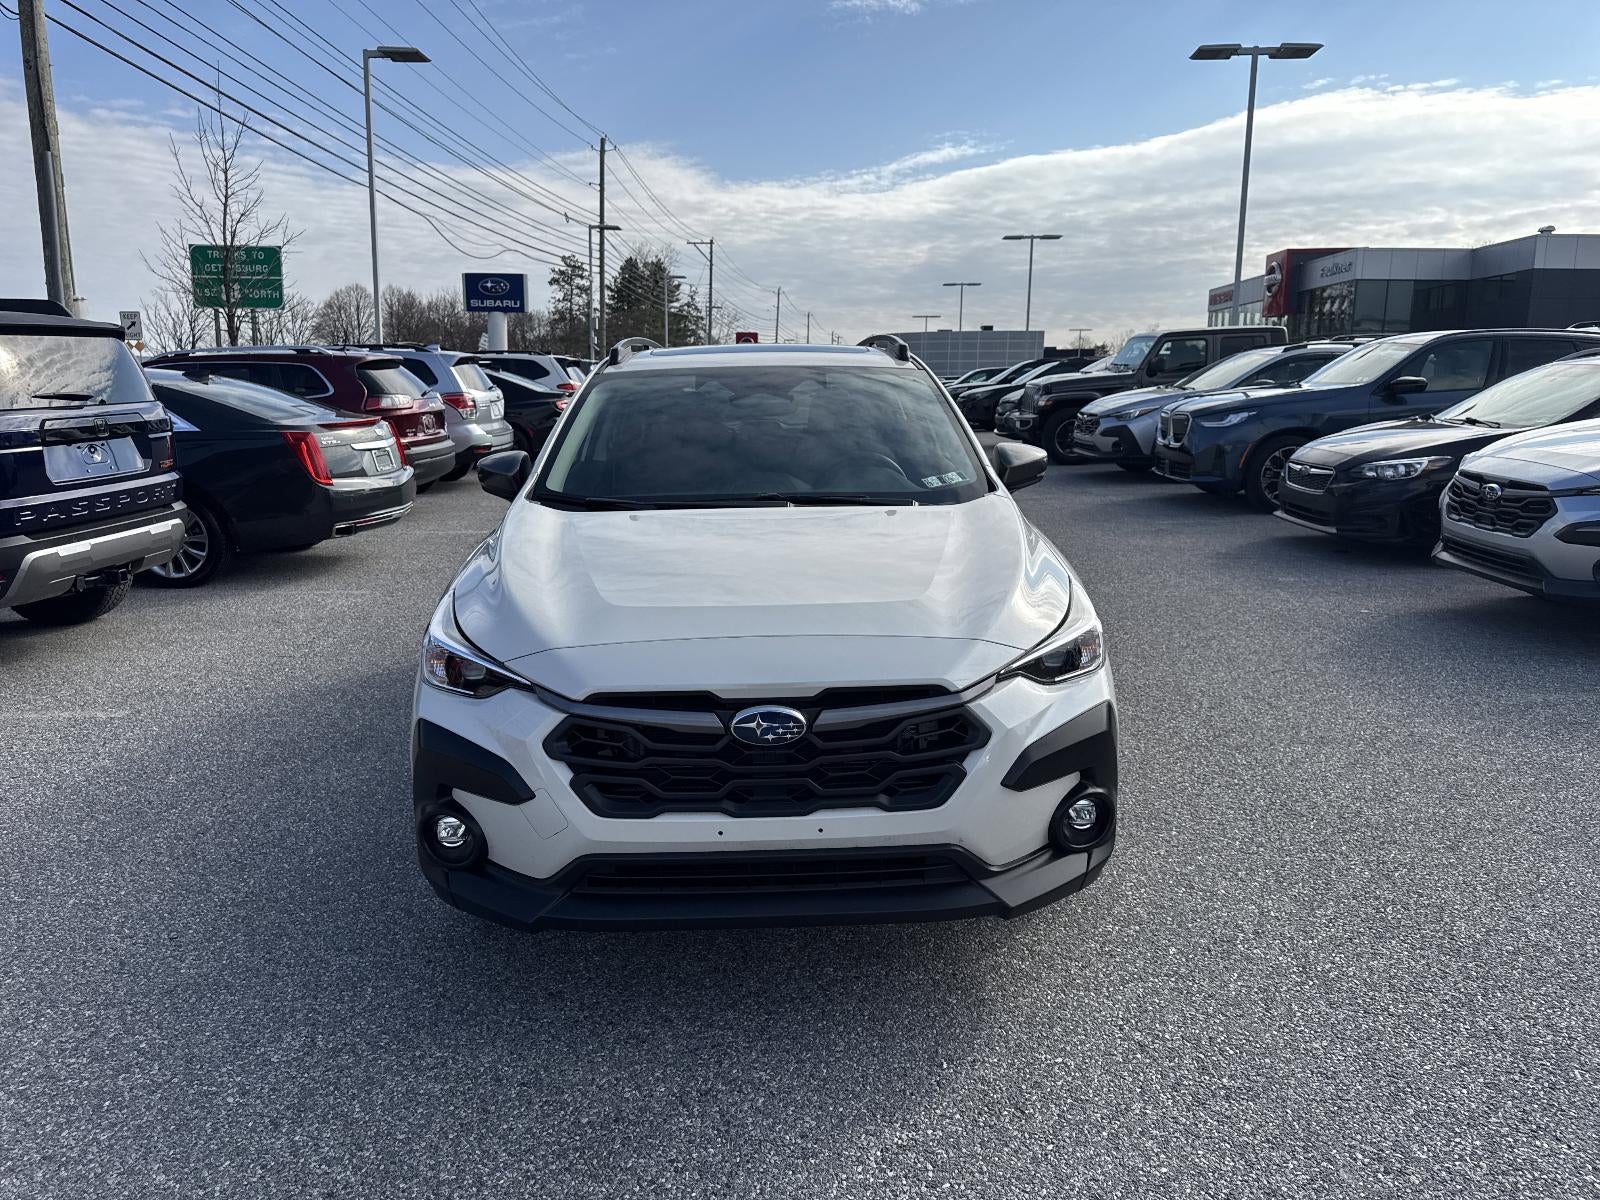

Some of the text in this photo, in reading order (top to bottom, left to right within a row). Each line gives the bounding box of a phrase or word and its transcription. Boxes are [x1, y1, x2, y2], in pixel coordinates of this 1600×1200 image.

[207, 250, 265, 260] TRKS TO
[204, 263, 269, 273] GETSBURG
[470, 299, 520, 308] SUBARU
[15, 482, 177, 526] PASSPORT
